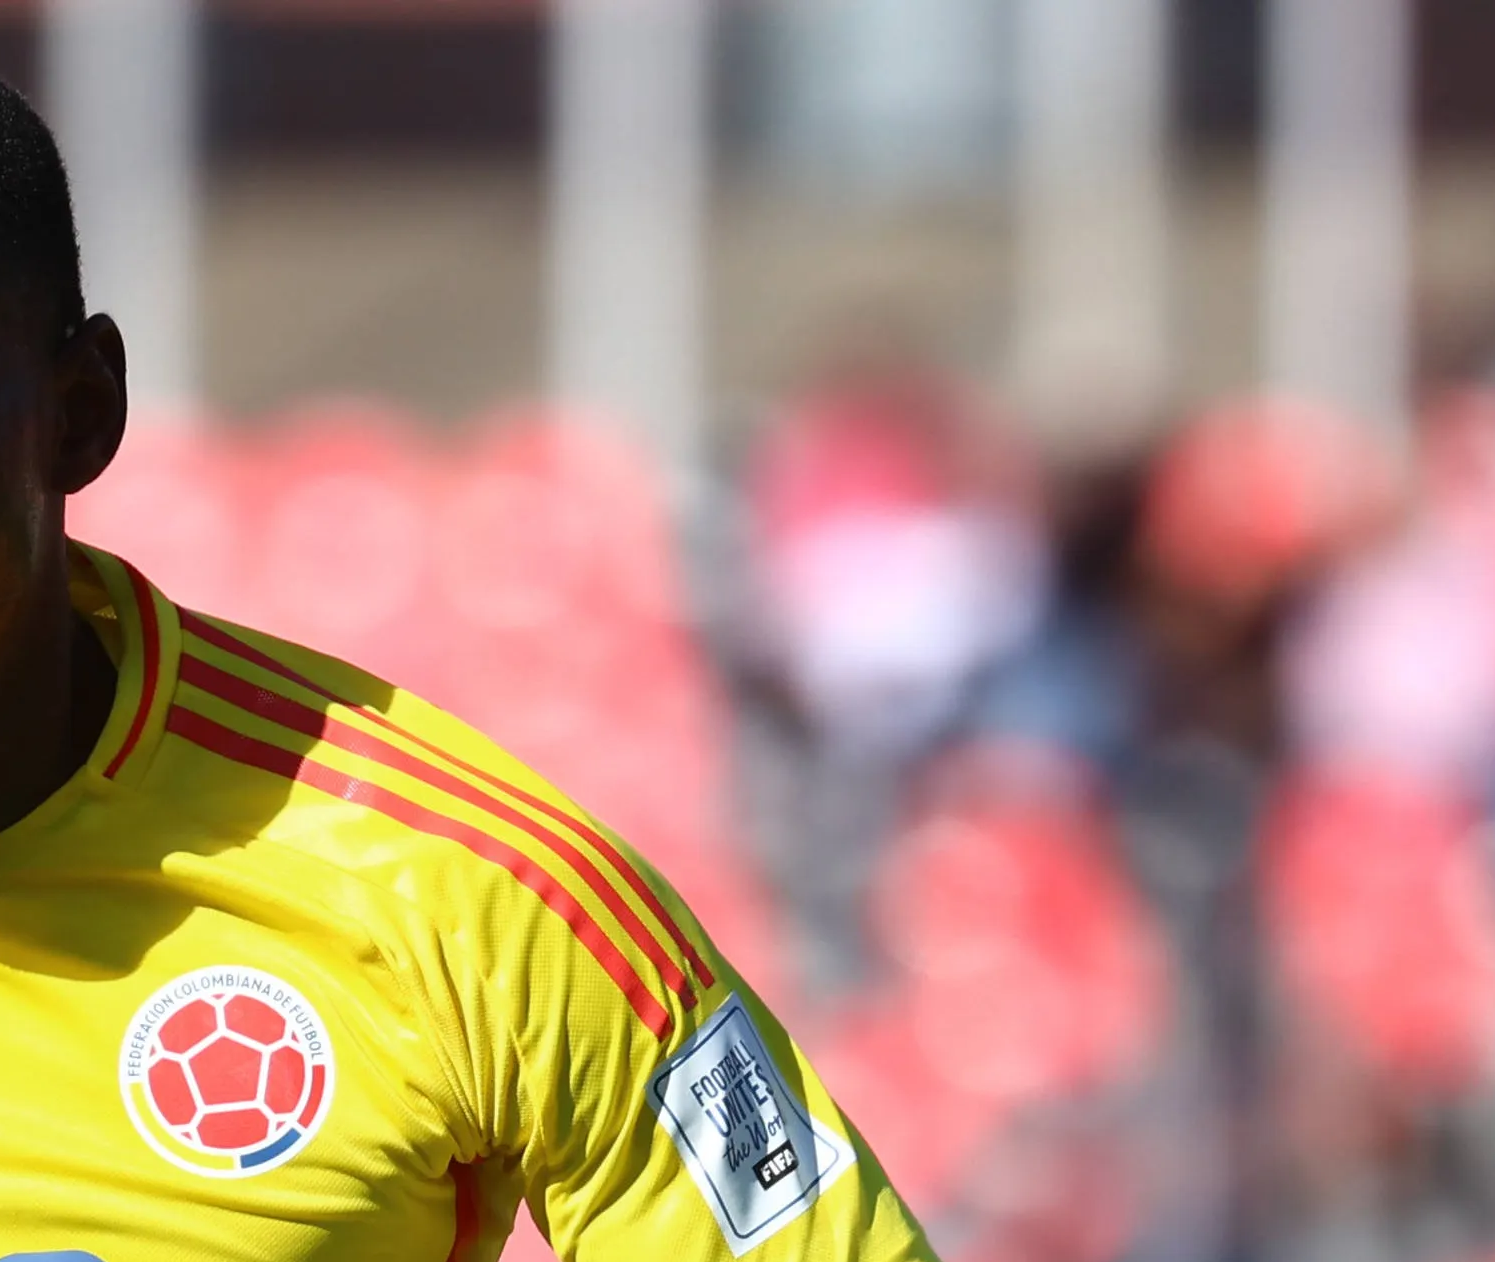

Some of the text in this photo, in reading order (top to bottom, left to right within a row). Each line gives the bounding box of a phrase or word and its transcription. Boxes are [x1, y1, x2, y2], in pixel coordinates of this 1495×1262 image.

[174, 973, 271, 1000] COLOMBIANA
[272, 989, 292, 1008] DE
[690, 1040, 756, 1107] FOOTBALL
[705, 1063, 774, 1138] UNITES
[722, 1138, 750, 1173] the
[760, 1148, 796, 1182] FIFA
